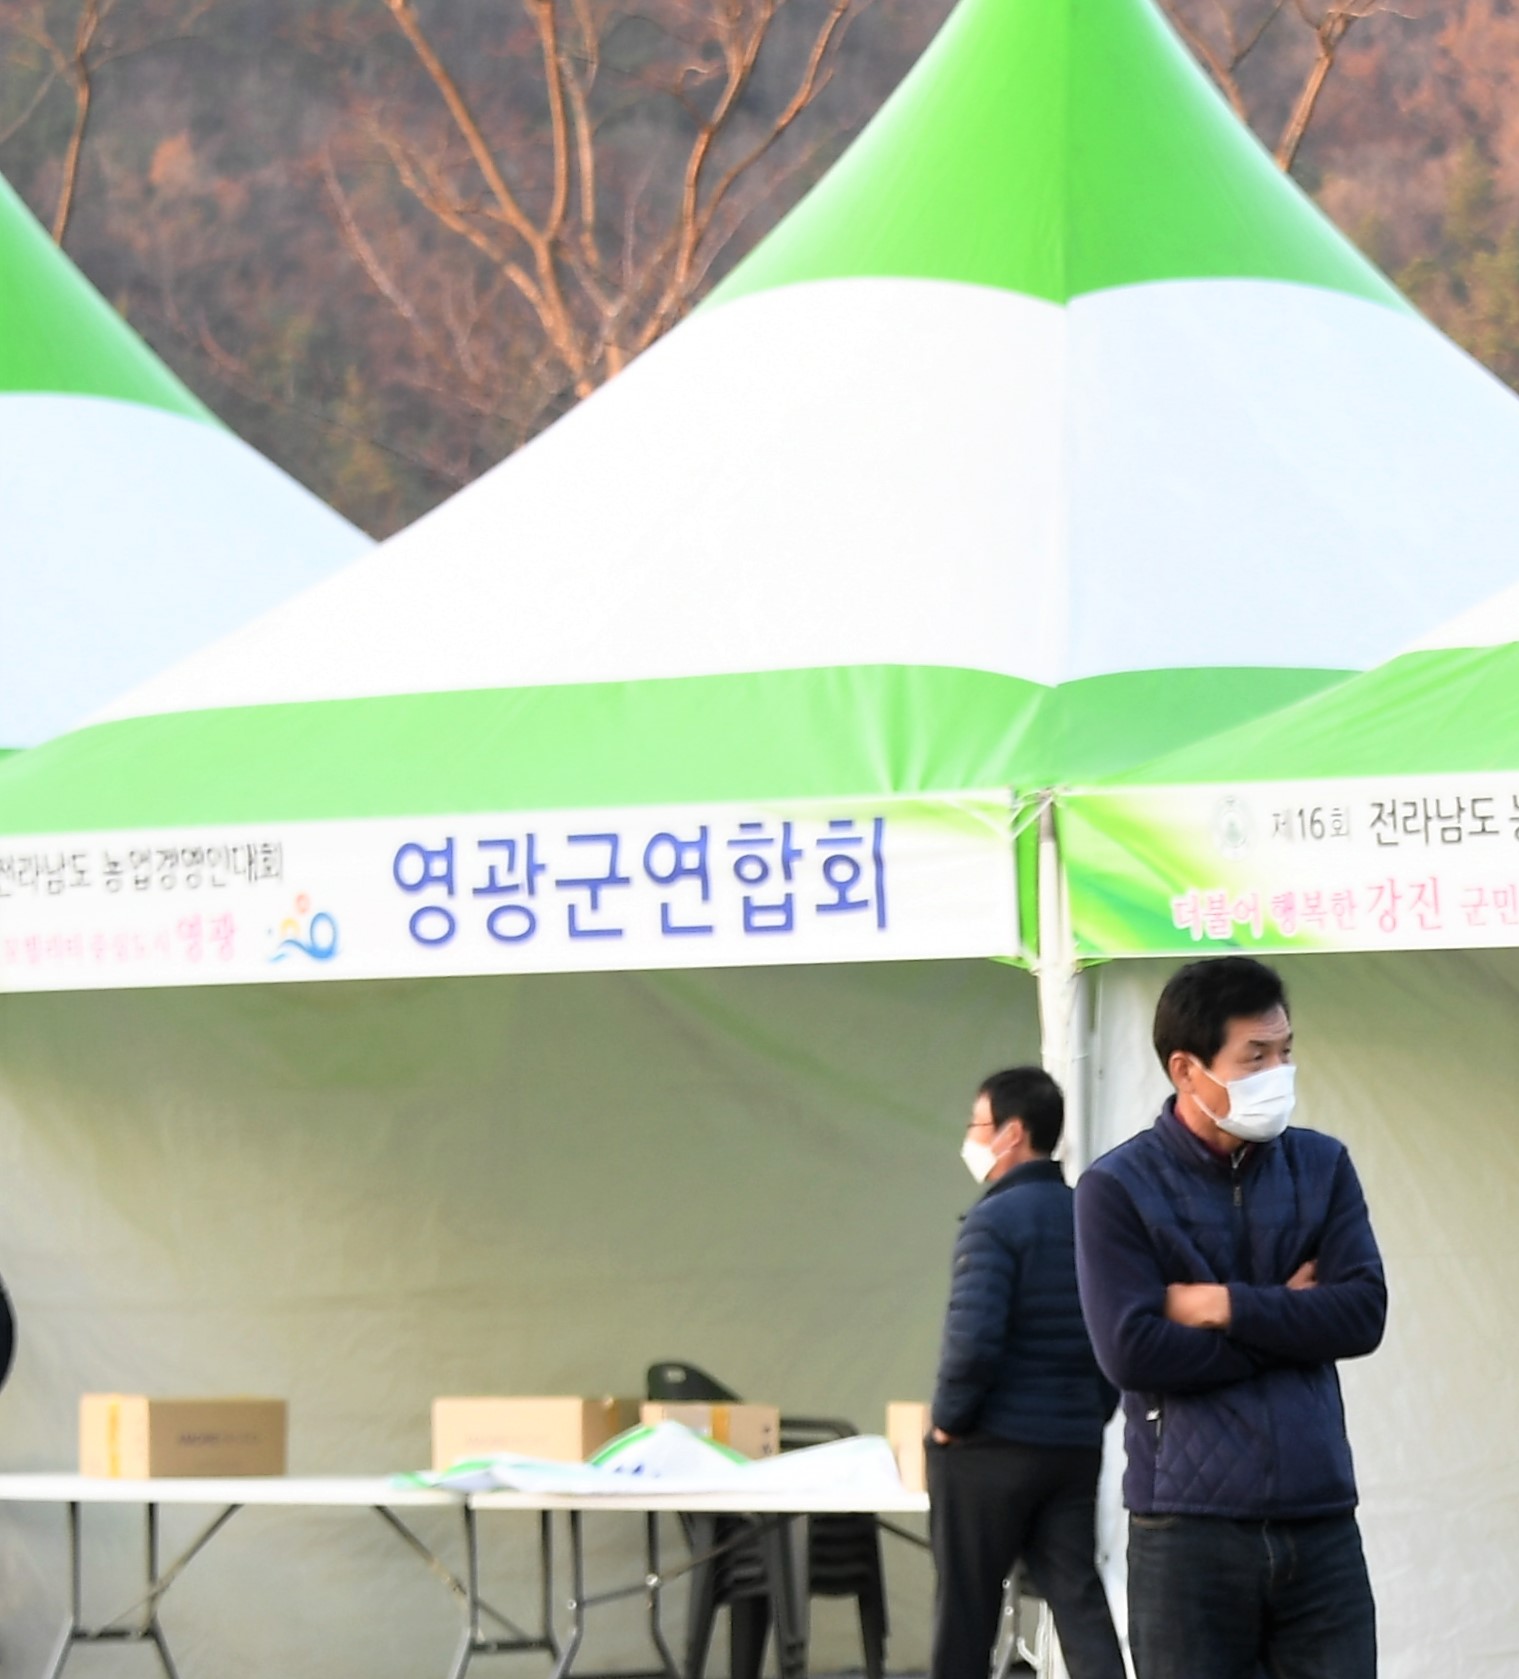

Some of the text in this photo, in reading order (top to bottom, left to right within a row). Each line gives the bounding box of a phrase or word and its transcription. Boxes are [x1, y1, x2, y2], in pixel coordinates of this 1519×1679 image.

[1370, 797, 1501, 846] 전라남도
[103, 842, 283, 893] 농업경영인대회
[393, 815, 889, 948] 영광군연합회
[1175, 893, 1262, 937] 더불어
[1271, 889, 1356, 935] 행복한
[1367, 876, 1442, 934] 강진
